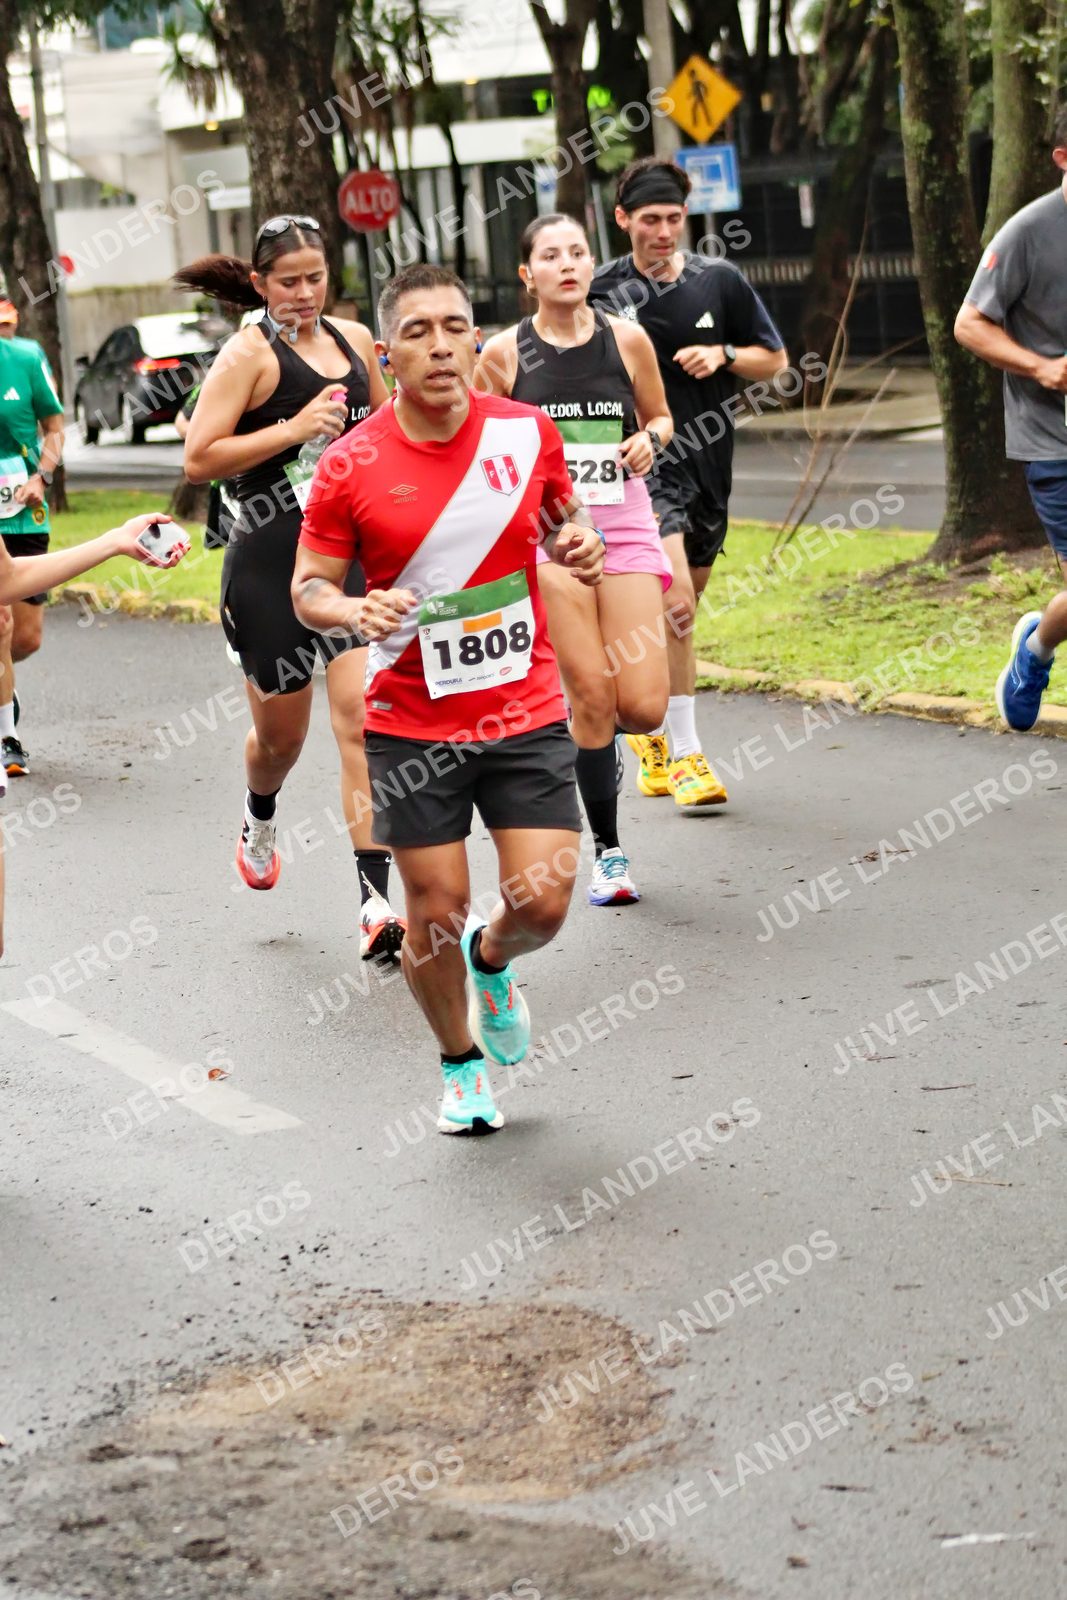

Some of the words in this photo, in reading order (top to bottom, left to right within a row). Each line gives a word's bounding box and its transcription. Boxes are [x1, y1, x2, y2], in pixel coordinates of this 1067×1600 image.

[343, 186, 398, 214] ALTO
[587, 401, 624, 417] LOCAL
[432, 620, 531, 671] 1808
